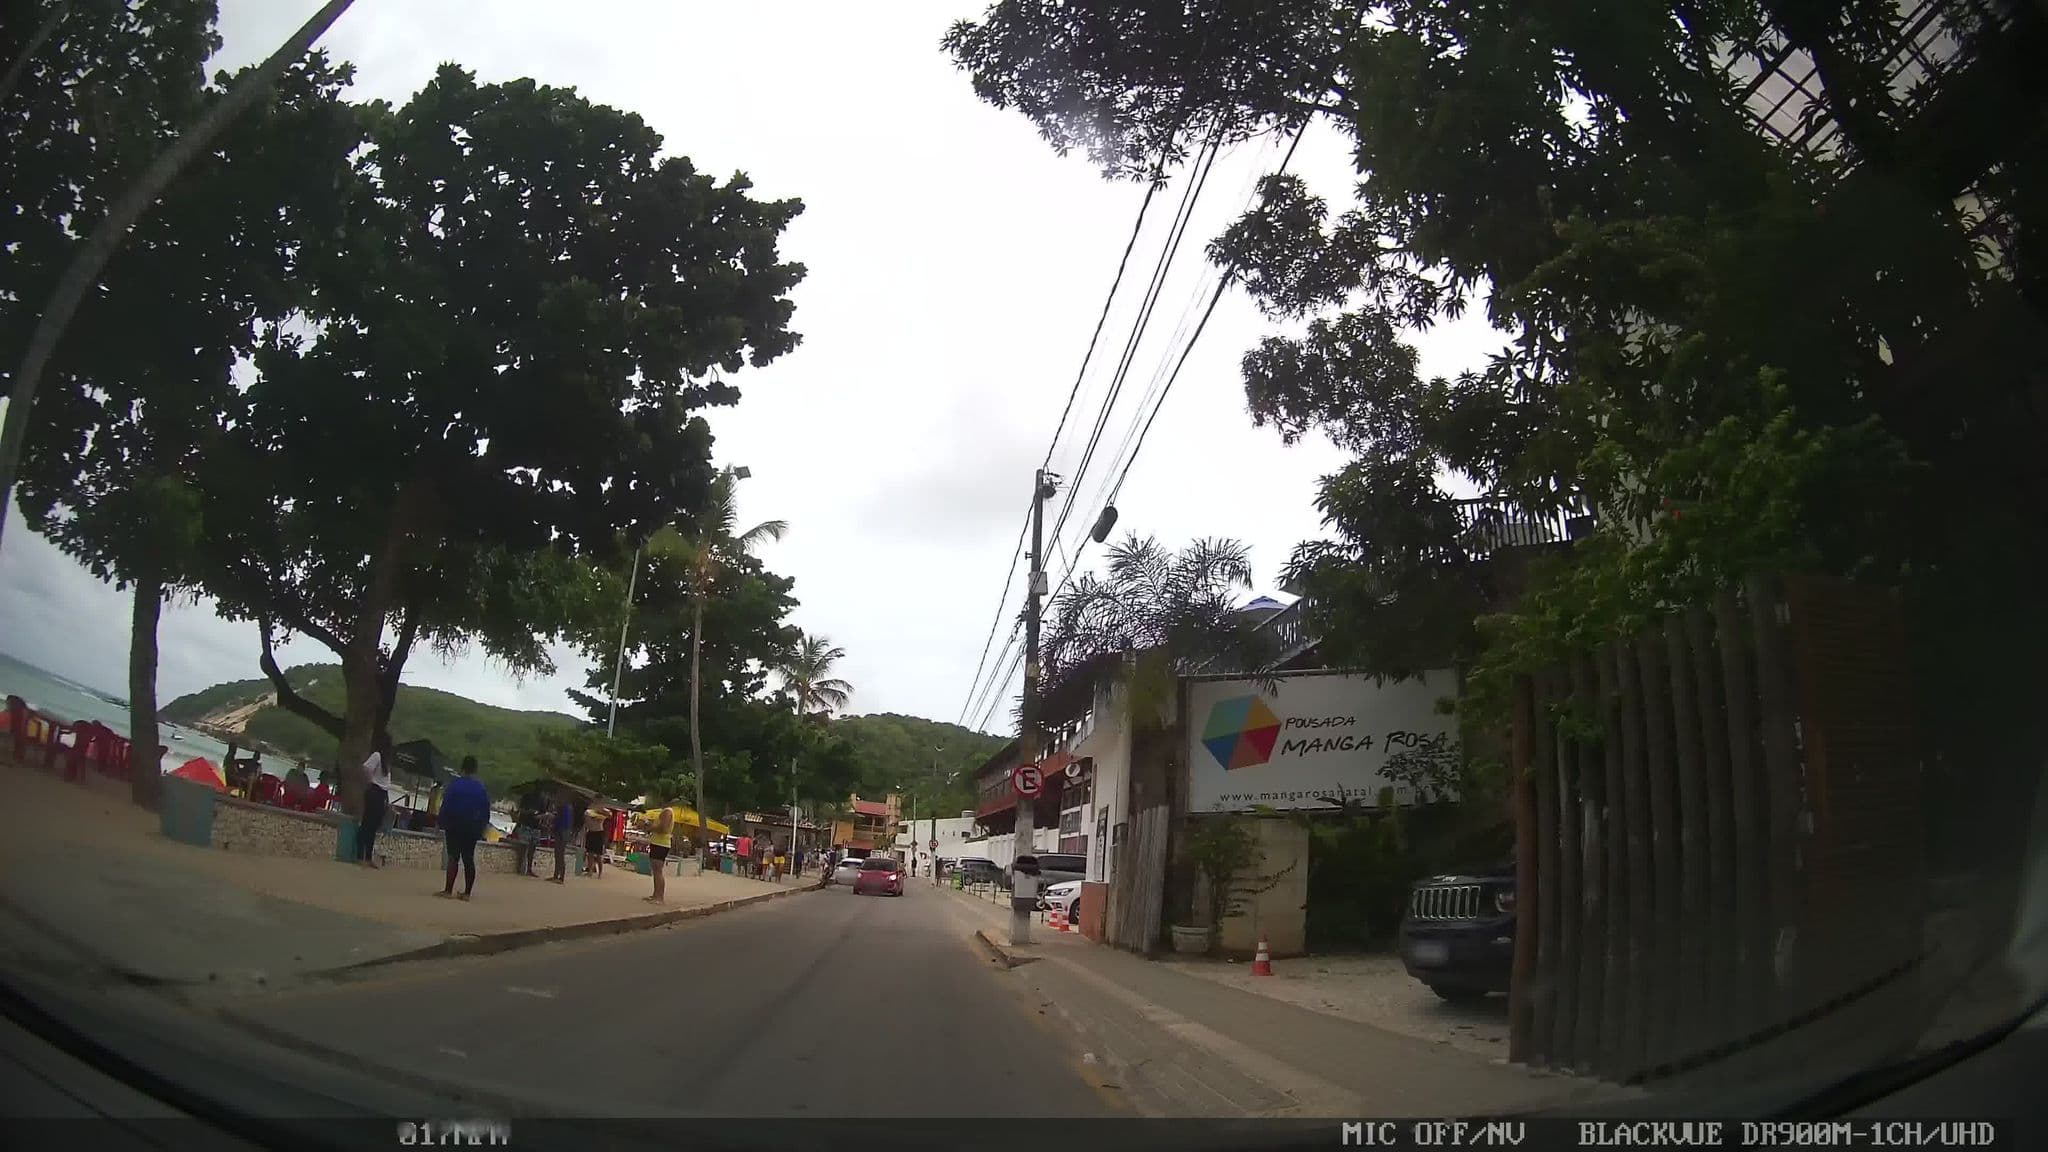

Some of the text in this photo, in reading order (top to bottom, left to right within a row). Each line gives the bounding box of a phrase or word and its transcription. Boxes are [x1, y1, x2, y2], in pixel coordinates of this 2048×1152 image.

[1285, 716, 1357, 730] POUSADA
[1281, 730, 1449, 758] MANGA ROSA
